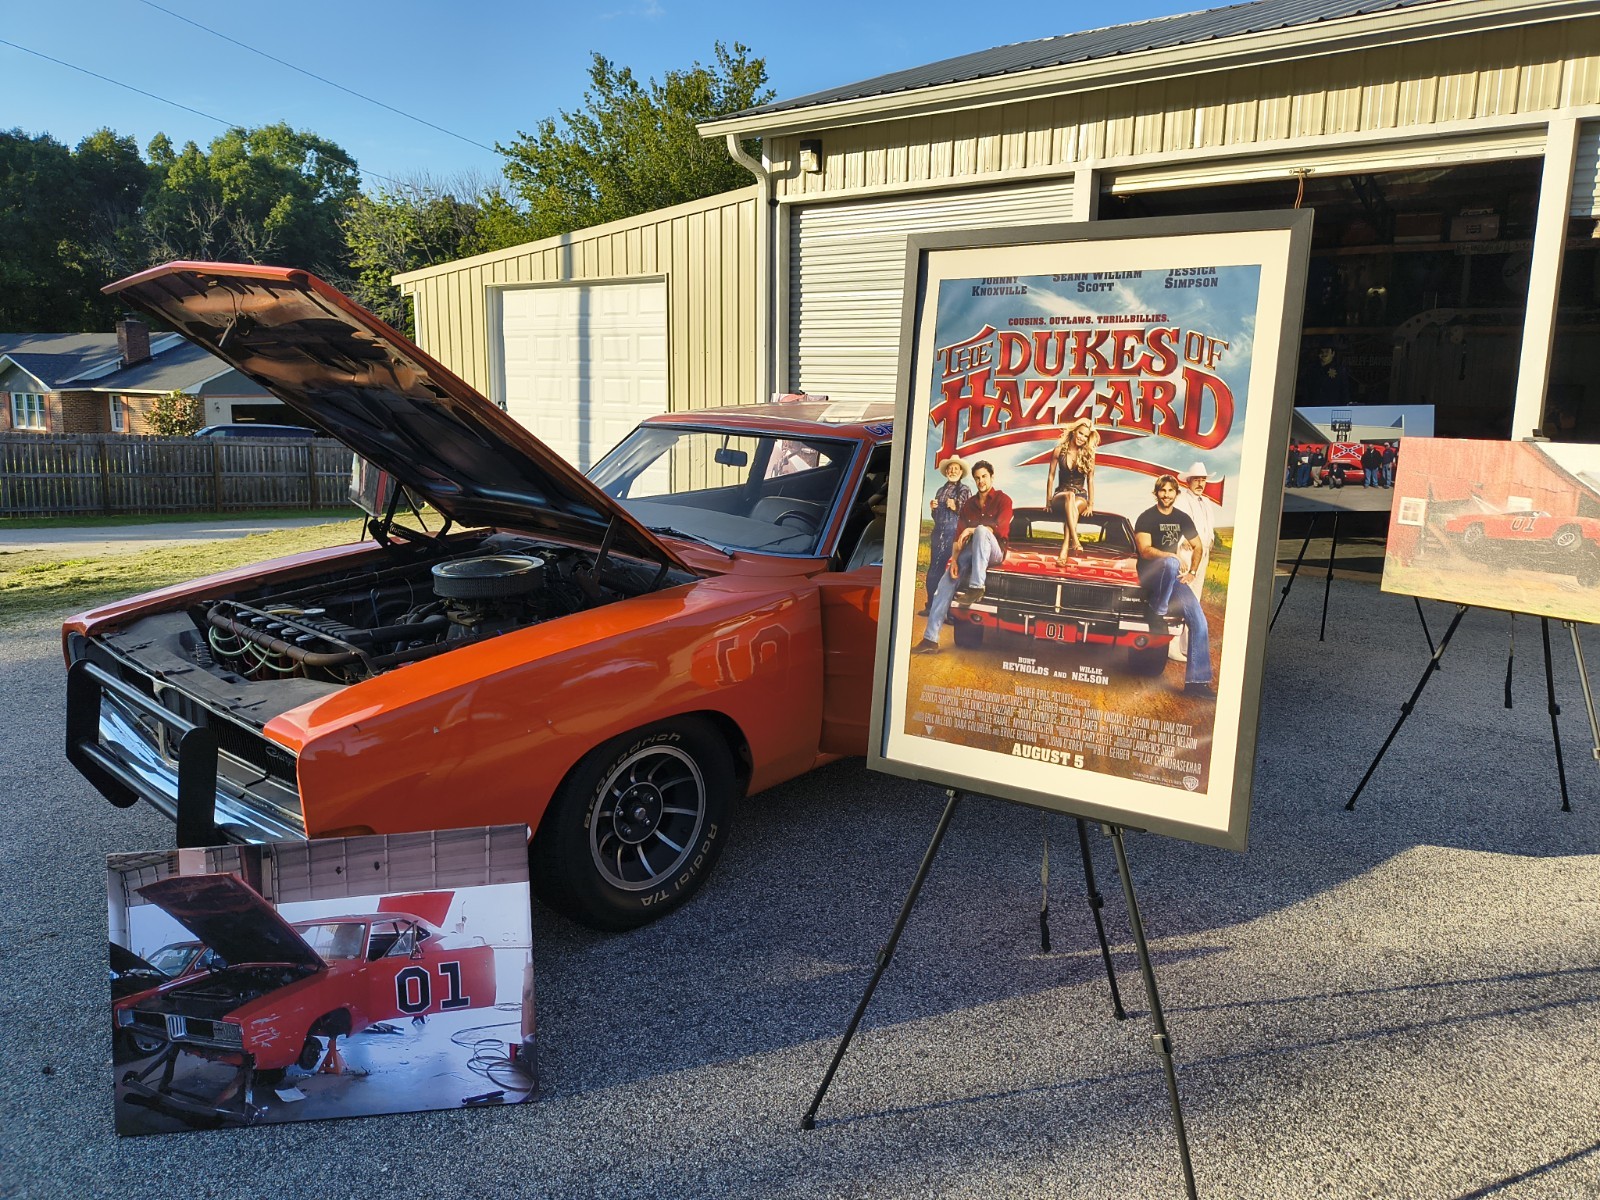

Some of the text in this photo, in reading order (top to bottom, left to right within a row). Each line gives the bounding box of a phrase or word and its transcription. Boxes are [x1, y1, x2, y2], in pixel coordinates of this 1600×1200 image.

[1052, 270, 1143, 282] SEANN WILLIAM
[1168, 266, 1216, 277] JESSICA
[981, 276, 1019, 285] JOHNNY
[1077, 281, 1114, 293] SCOTT
[1164, 277, 1219, 289] SIMPSON
[971, 285, 1028, 297] KNOXVILLE
[1008, 314, 1170, 326] COUSINS. OUTLAWS. THRILLBILLIES.
[937, 324, 1229, 378] THE DUKES OF
[929, 365, 1235, 469] HAZZARD
[1511, 515, 1536, 532] 01
[1045, 622, 1065, 640] 01
[1018, 656, 1037, 665] BURT
[1002, 661, 1109, 685] REYNOLDS AND NELSON
[1079, 665, 1103, 675] WILLIE
[1175, 723, 1192, 737] SCOTT
[1012, 742, 1071, 766] AUGUST
[1073, 754, 1084, 769] 5
[640, 823, 718, 907] Radial T/A
[394, 960, 471, 1015] 01
